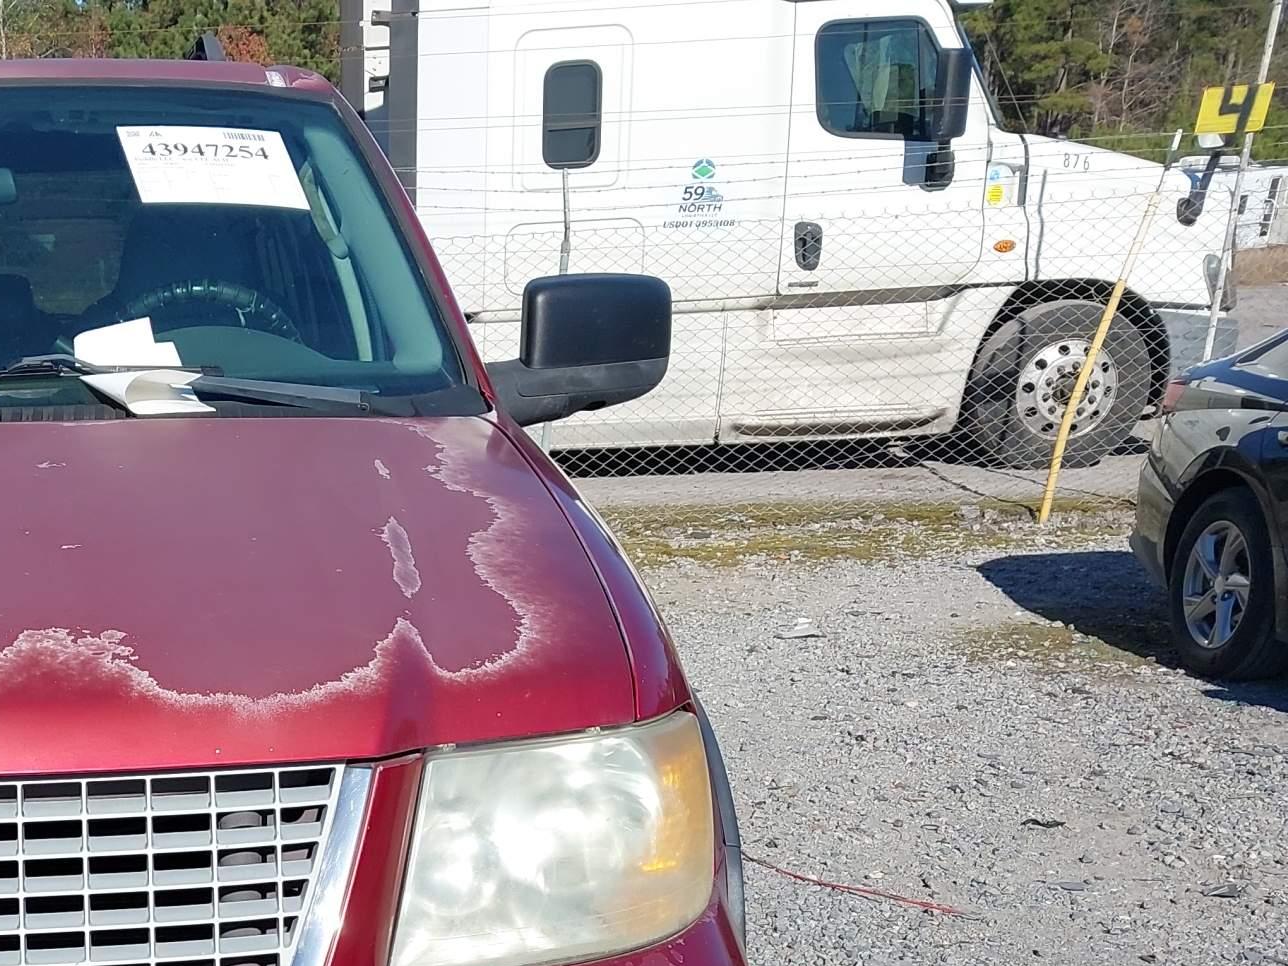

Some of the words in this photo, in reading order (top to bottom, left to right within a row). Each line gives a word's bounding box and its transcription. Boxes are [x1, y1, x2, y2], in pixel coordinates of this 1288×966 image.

[1217, 84, 1261, 133] 4
[142, 142, 270, 160] 43947254
[1063, 152, 1090, 170] 876
[681, 185, 706, 201] 59
[677, 203, 723, 213] NORTH
